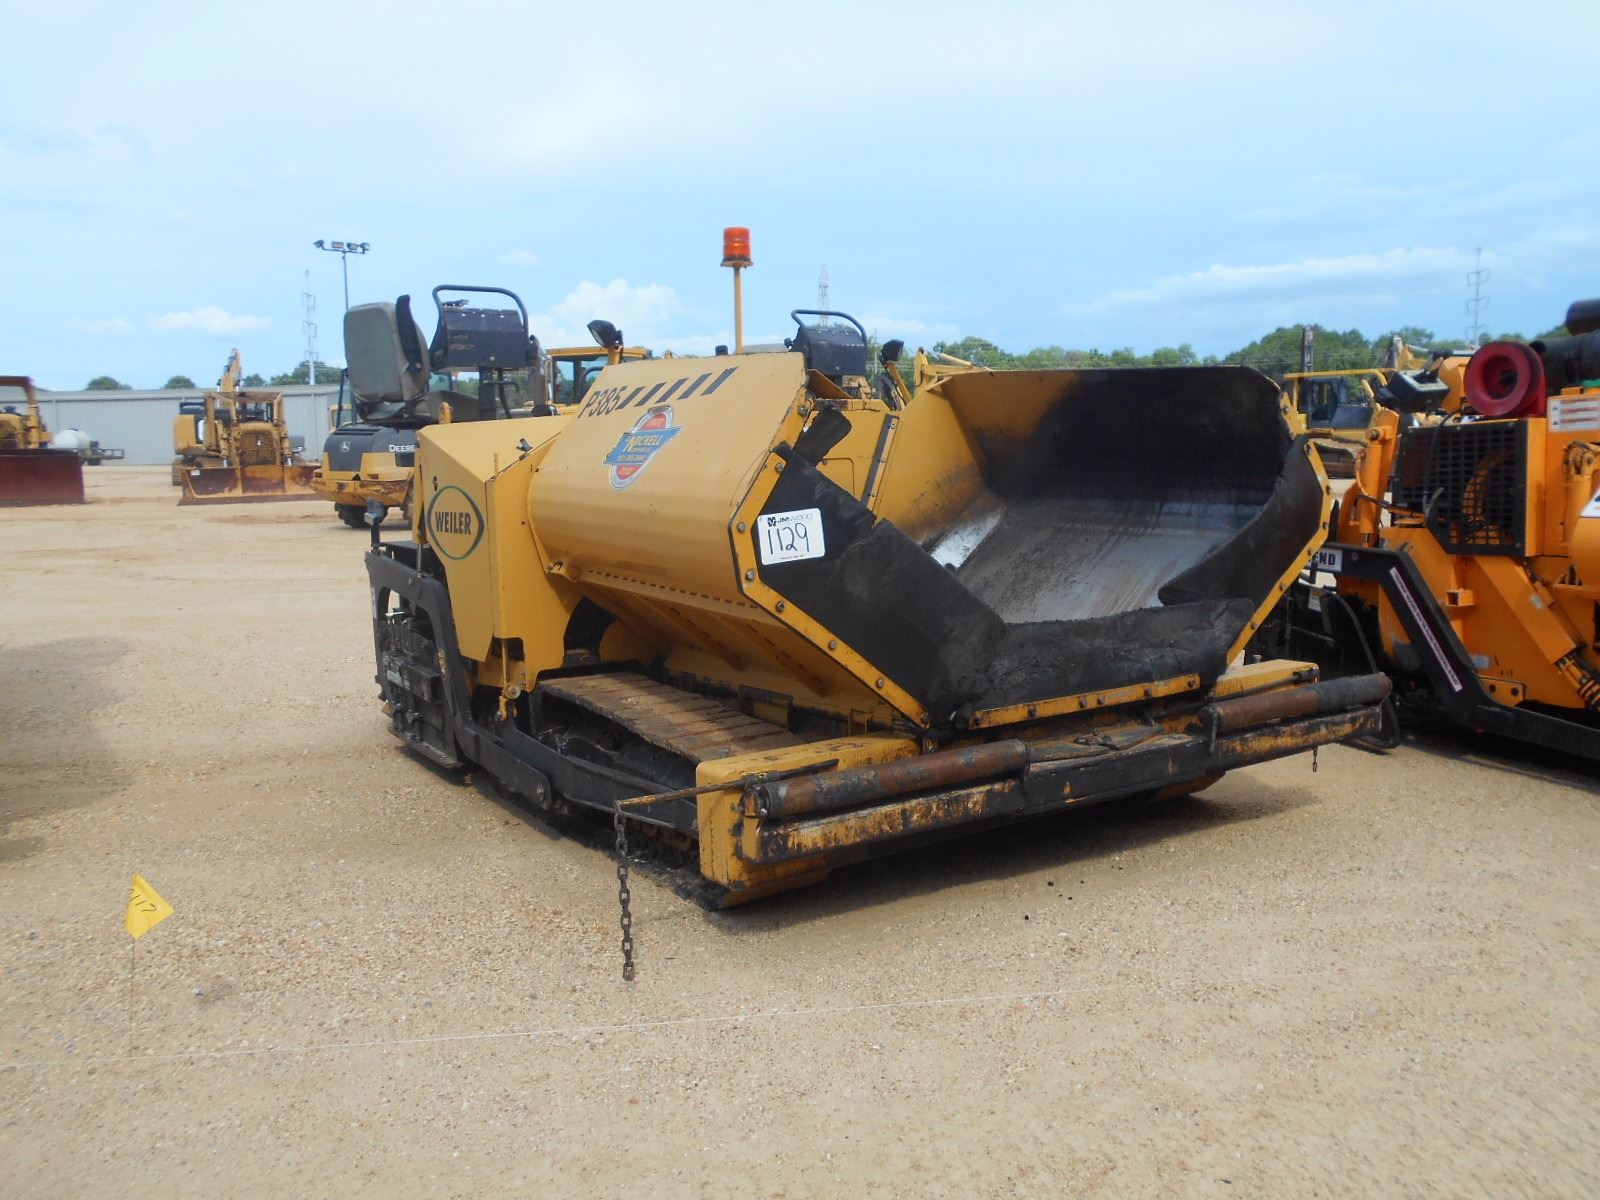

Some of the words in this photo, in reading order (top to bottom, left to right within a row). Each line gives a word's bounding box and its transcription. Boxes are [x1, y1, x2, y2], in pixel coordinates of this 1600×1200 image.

[578, 386, 628, 418] P385
[435, 511, 472, 535] WEILER
[767, 522, 810, 555] 1129
